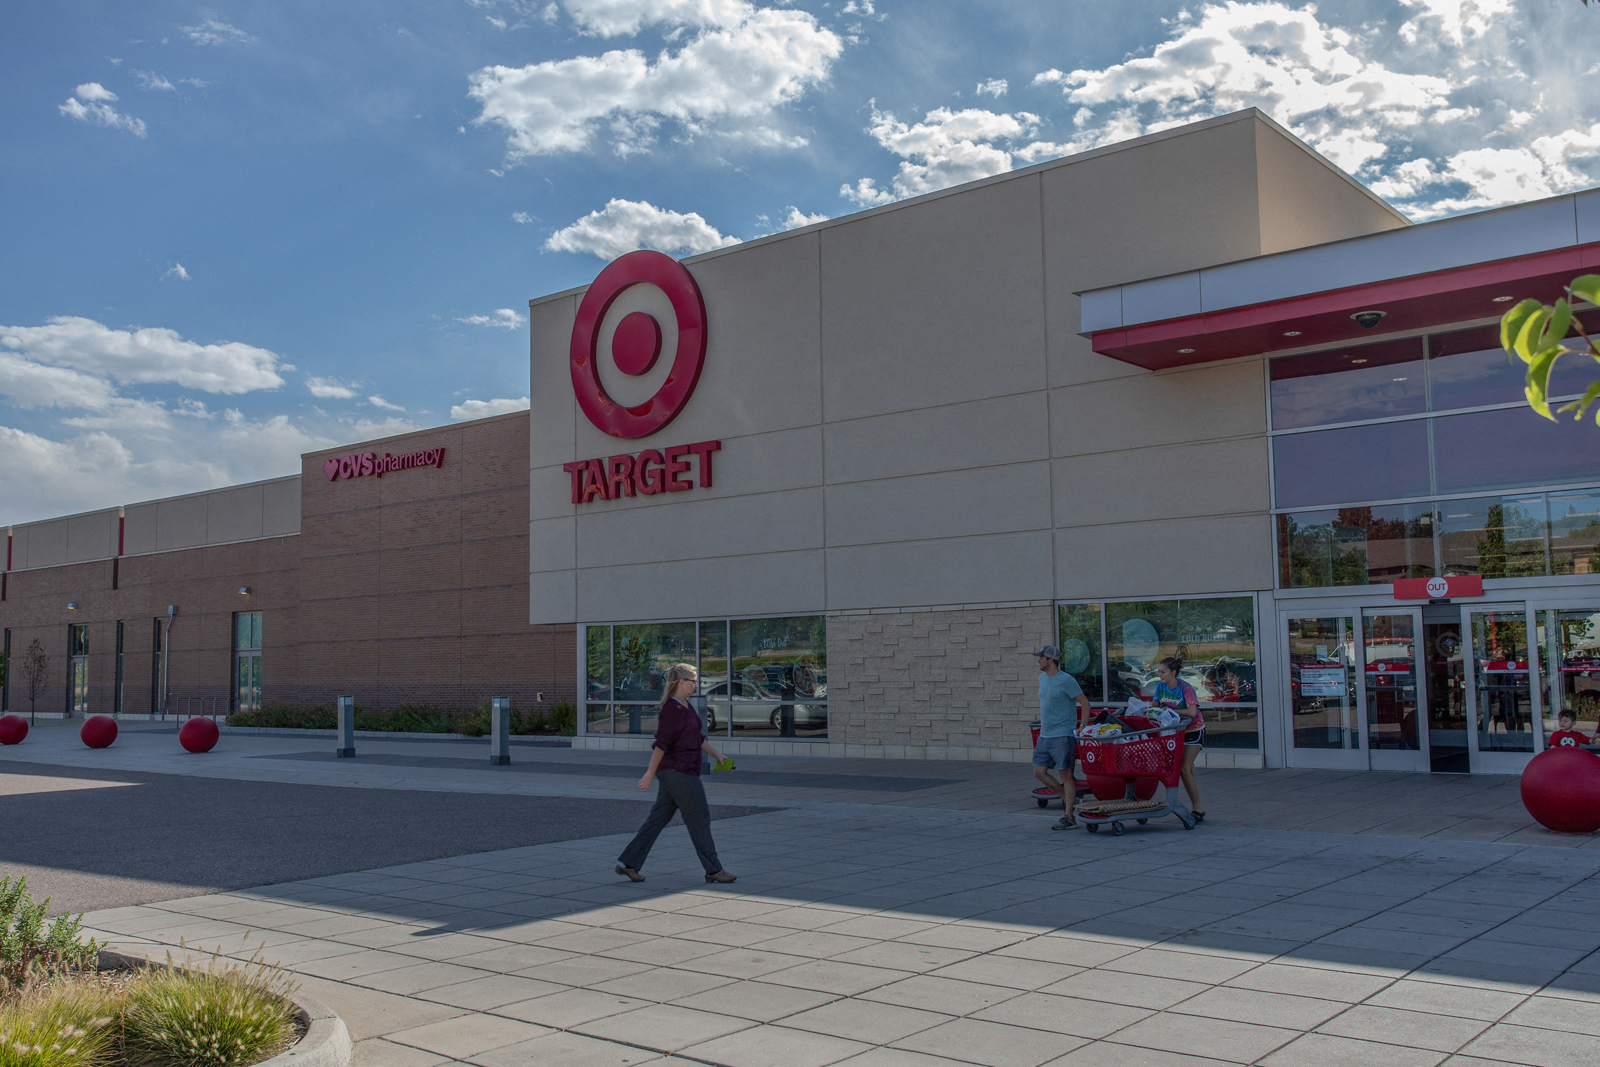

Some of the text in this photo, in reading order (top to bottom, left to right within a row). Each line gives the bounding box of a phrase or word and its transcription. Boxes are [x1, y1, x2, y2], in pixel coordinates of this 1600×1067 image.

[339, 447, 445, 479] CVS pharmacy
[563, 440, 721, 504] TARGET
[1427, 583, 1446, 591] OUT
